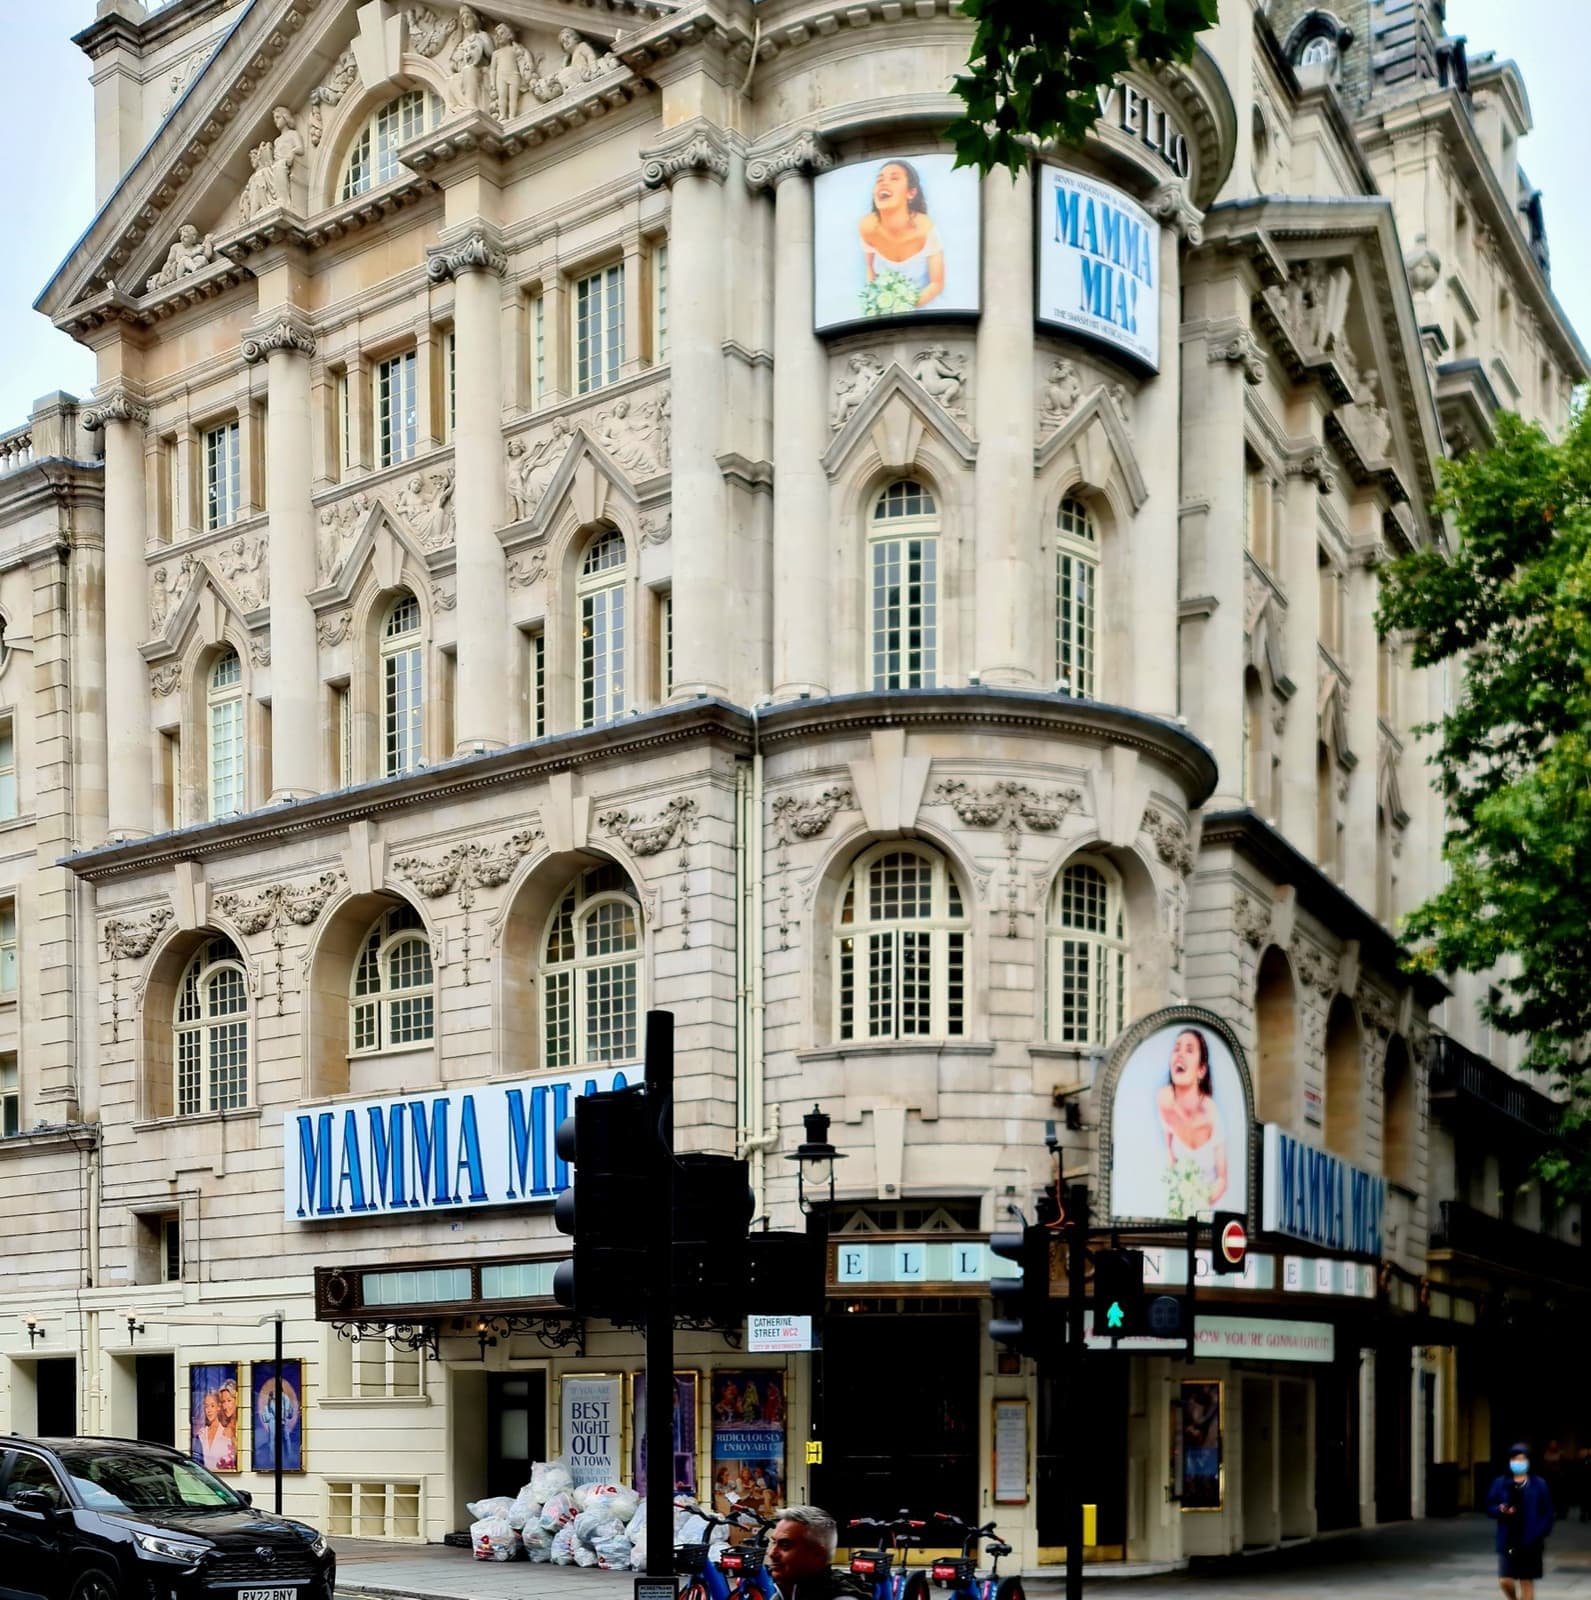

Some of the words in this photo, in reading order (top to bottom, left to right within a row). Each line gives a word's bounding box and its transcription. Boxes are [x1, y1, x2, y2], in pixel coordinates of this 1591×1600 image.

[1054, 185, 1152, 289] MAMMA
[1079, 254, 1137, 335] MIA!
[297, 1095, 489, 1217] MAMMA
[506, 1071, 629, 1199] MI
[1279, 1135, 1344, 1250] MAMMA
[753, 1317, 793, 1328] CATHERINE
[753, 1328, 780, 1338] STREET
[571, 1402, 610, 1419] BEST
[571, 1420, 610, 1435] NIGHT
[572, 1435, 610, 1455] OUT
[571, 1456, 580, 1466] IN
[584, 1456, 611, 1467] TOWN
[273, 1589, 293, 1600] BNY
